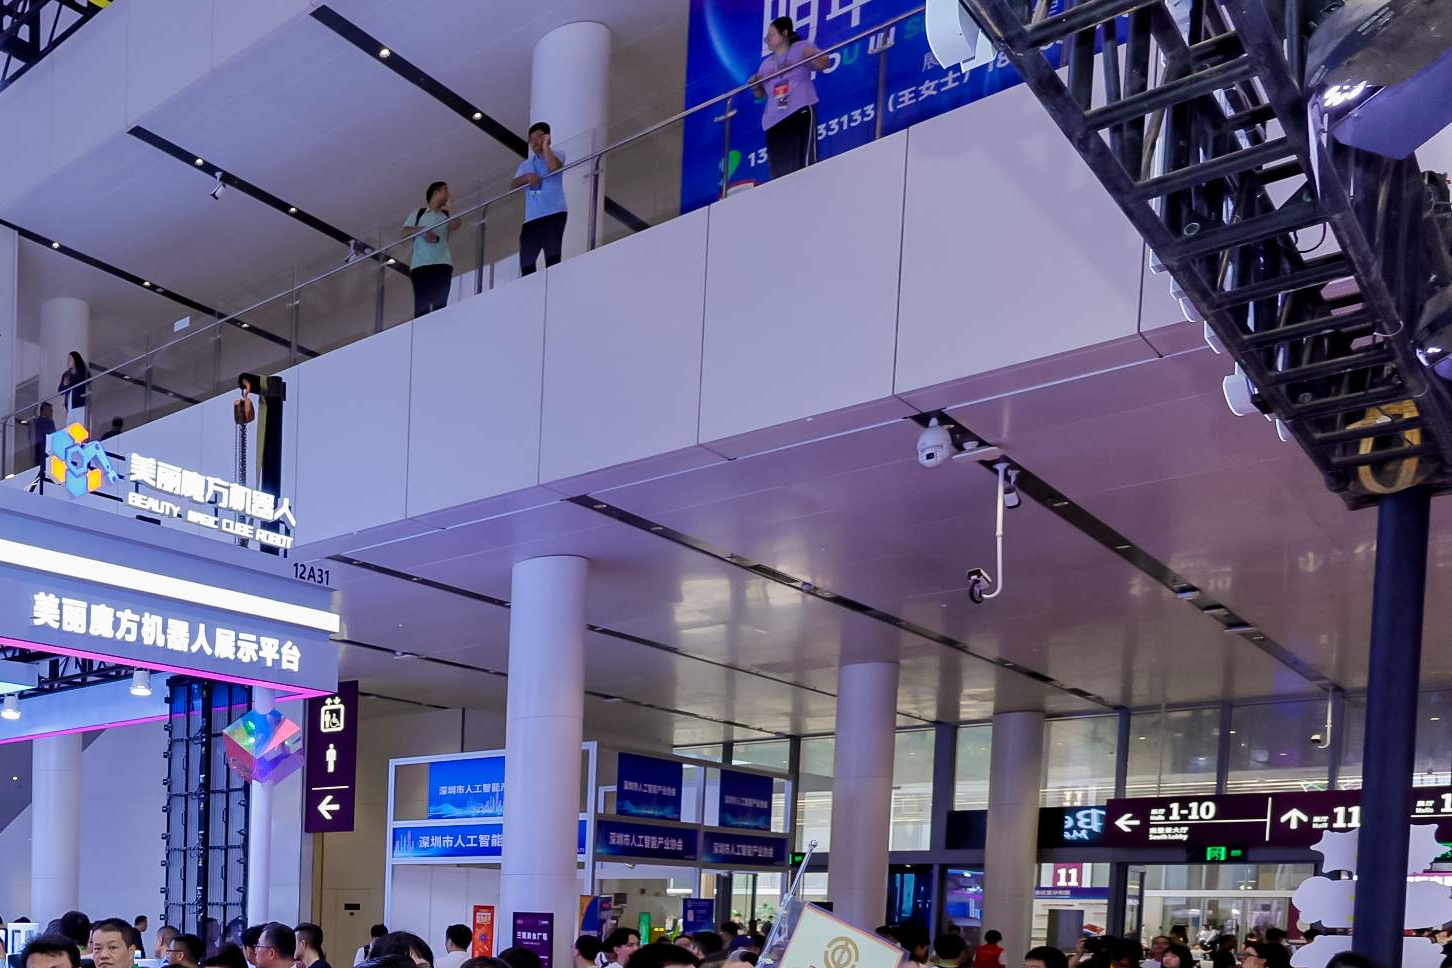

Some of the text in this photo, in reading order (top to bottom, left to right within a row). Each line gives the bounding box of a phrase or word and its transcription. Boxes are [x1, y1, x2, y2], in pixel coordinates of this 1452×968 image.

[129, 452, 296, 528] 美丽魔方机器人
[128, 491, 181, 518] BEAUTY
[221, 518, 254, 538] CUBE
[255, 528, 294, 549] ROBOT
[293, 562, 330, 586] 12A31
[32, 591, 301, 672] 美丽魔方机器人展示平台
[1168, 801, 1216, 820] 1-10
[1332, 805, 1361, 828] 11
[1056, 868, 1079, 887] 11
